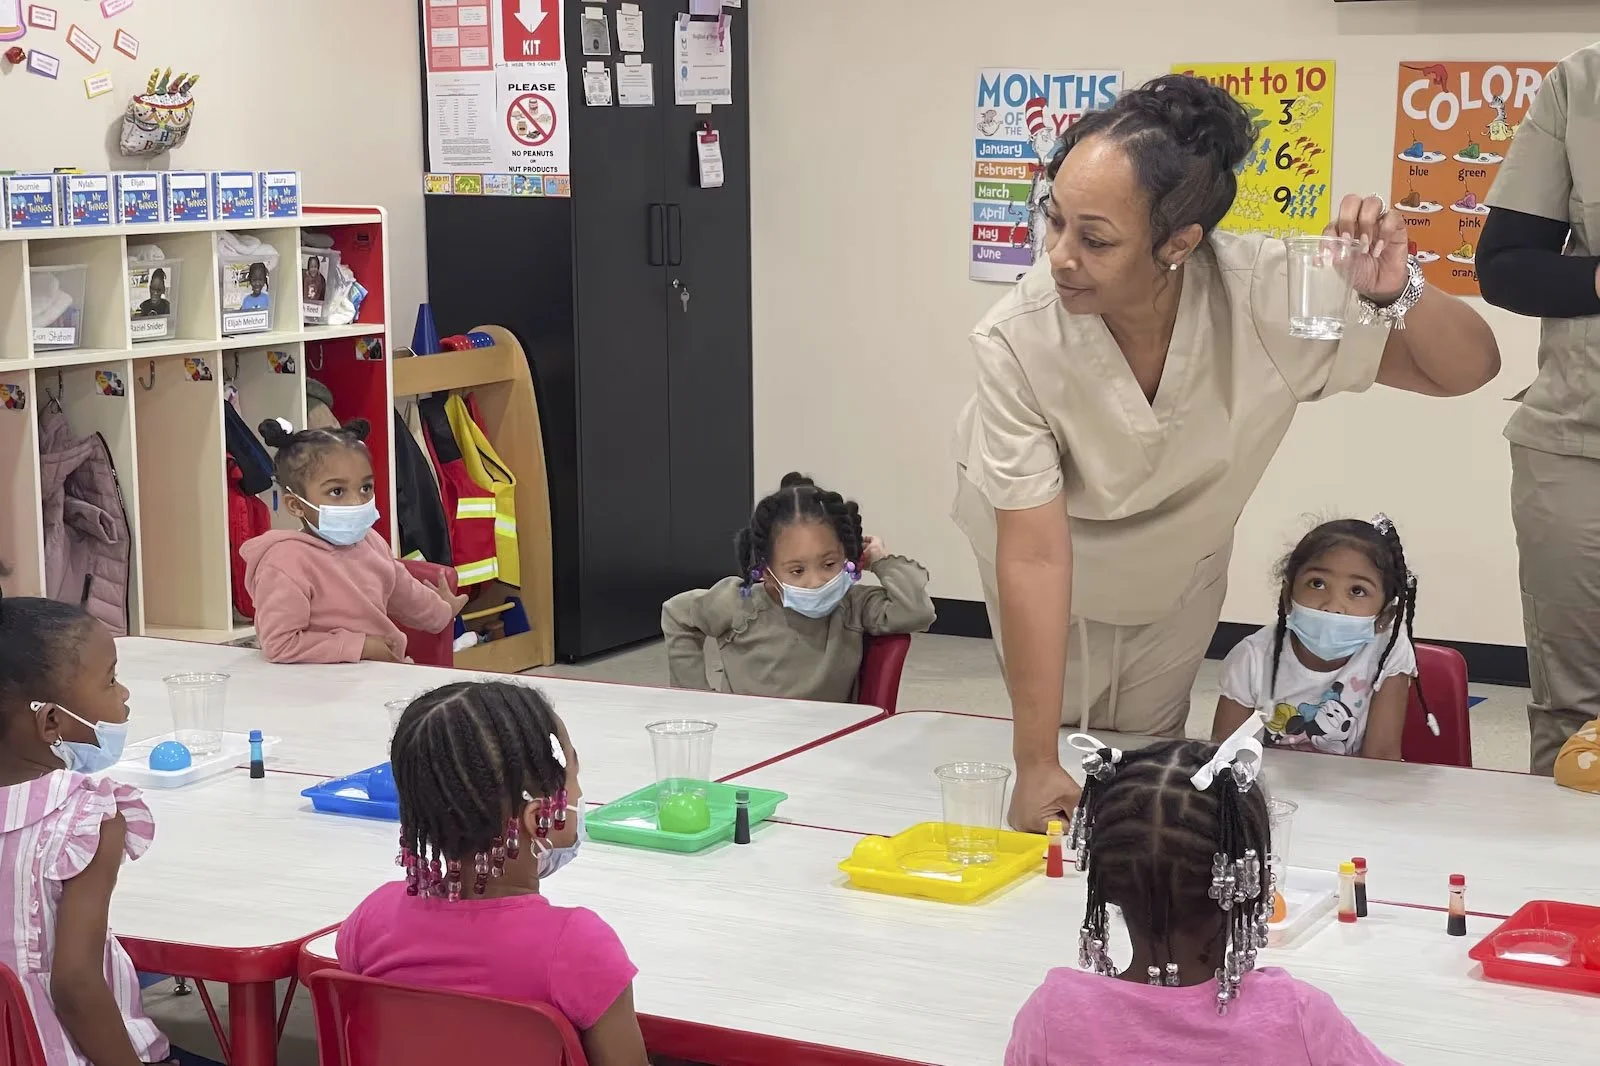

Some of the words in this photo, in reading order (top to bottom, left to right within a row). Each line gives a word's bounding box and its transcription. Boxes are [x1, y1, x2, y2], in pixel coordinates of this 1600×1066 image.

[522, 39, 541, 56] KIT
[508, 83, 556, 91] PLEASE
[1260, 66, 1287, 95] to
[1295, 66, 1326, 93] 10
[978, 72, 1117, 110] MONTHS
[1004, 112, 1024, 126] OF
[1279, 99, 1296, 125] 3
[1005, 126, 1022, 136] THE
[980, 143, 1022, 157] January
[1275, 142, 1293, 170] 6
[978, 163, 1026, 178] February
[1409, 165, 1429, 176] blue
[1458, 168, 1487, 182] green
[978, 184, 1010, 199] March
[87, 201, 109, 211] THINGS
[137, 200, 158, 210] THINGS
[186, 198, 207, 207] THINGS
[234, 197, 253, 207] THINGS
[279, 196, 297, 205] THINGS
[1273, 186, 1292, 214] 9
[28, 203, 52, 213] THINGS
[980, 207, 1005, 220] April
[1459, 217, 1481, 231] pink
[977, 227, 999, 242] May
[977, 247, 1002, 260] June
